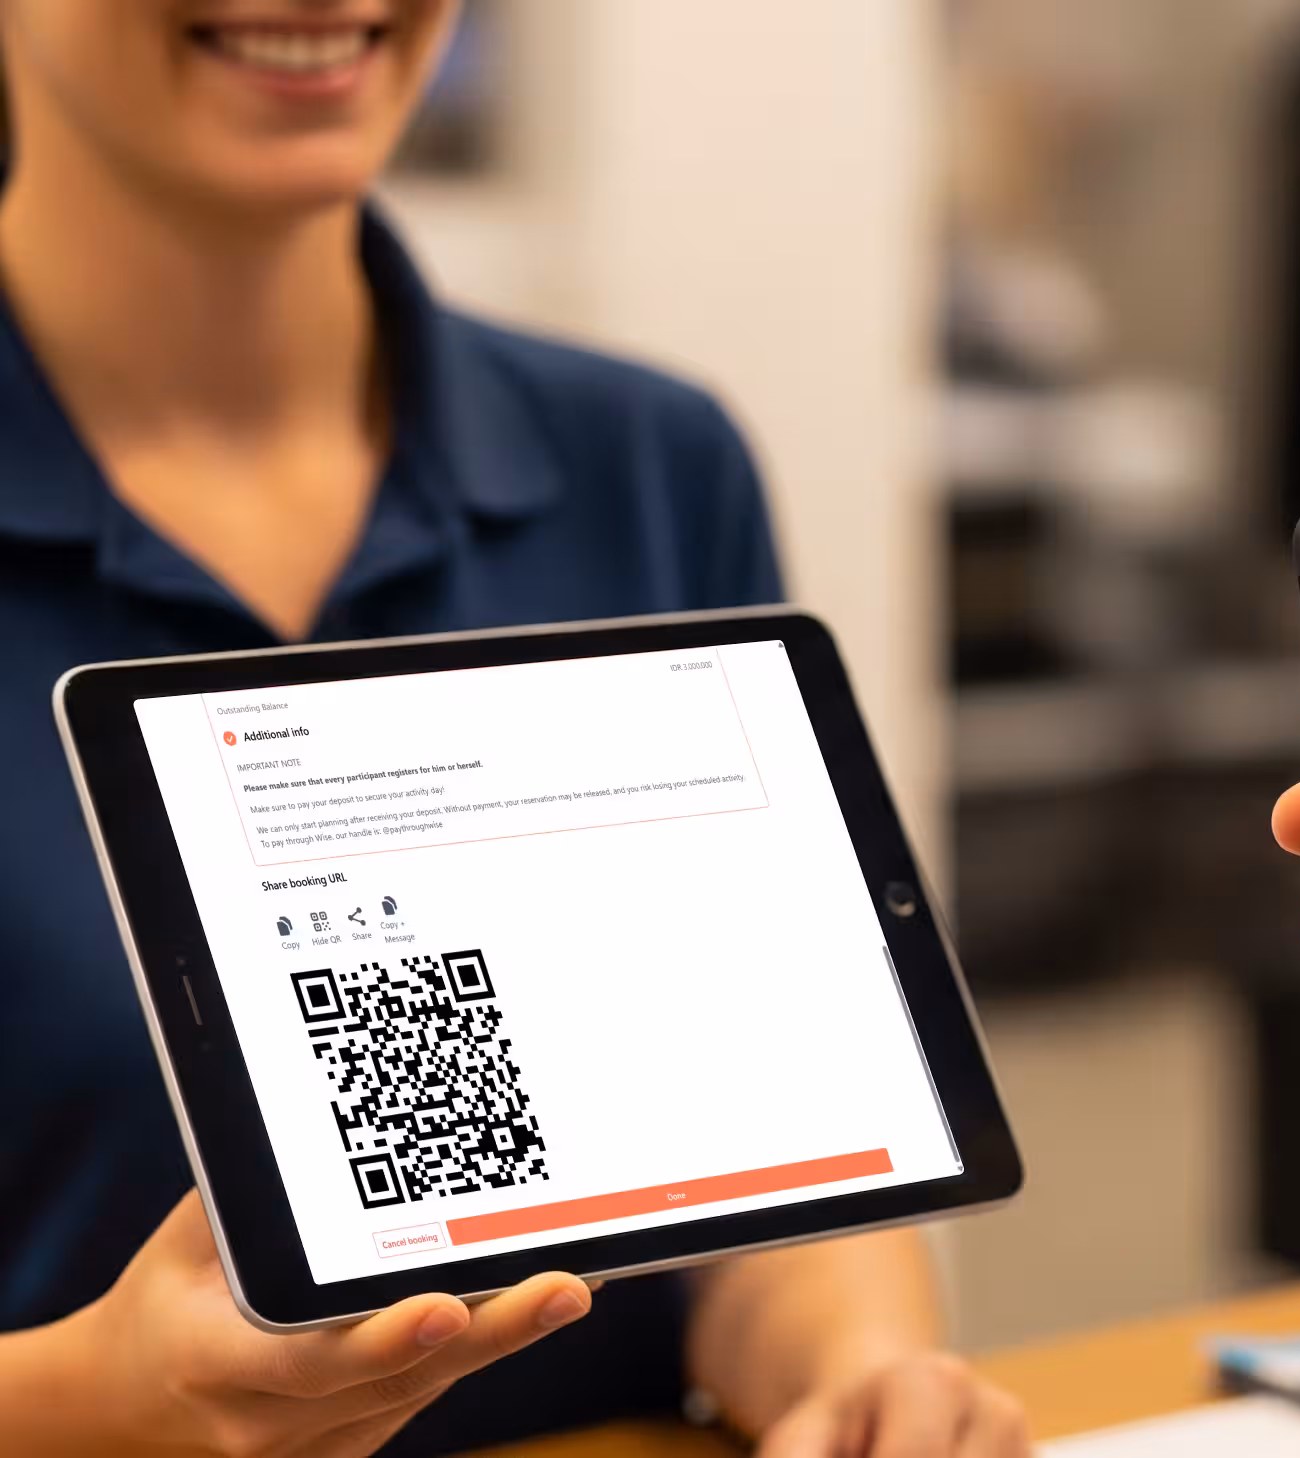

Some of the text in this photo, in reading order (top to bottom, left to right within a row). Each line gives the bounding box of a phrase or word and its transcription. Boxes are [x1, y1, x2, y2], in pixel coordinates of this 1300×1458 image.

[216, 703, 288, 715] Outstanding Balance
[244, 726, 309, 742] Additional info
[237, 758, 301, 773] IMPORTANT NOTE
[243, 784, 267, 792] Please
[268, 781, 289, 790] make
[324, 776, 345, 784] every
[346, 771, 386, 783] participant
[387, 769, 419, 778] registers
[419, 766, 430, 774] for
[456, 760, 483, 769] herself.
[250, 805, 270, 813] Make
[297, 802, 310, 811] pay
[311, 800, 327, 809] your
[329, 796, 355, 807] deposit
[388, 792, 404, 800] your
[405, 788, 429, 797] activity
[256, 826, 269, 834] We
[284, 823, 299, 832] only
[301, 821, 317, 830] start
[318, 818, 349, 829] planning
[349, 816, 365, 824] after
[367, 812, 399, 822] receiving
[399, 812, 414, 820] your
[443, 804, 472, 813] Without
[472, 801, 504, 812] payment,
[504, 800, 519, 808] your
[520, 795, 557, 804] reservation
[583, 788, 612, 798] released,
[613, 786, 626, 794] and
[626, 787, 639, 795] you
[652, 782, 673, 790] losing
[673, 781, 687, 790] your
[688, 776, 721, 786] scheduled
[260, 840, 270, 848] To
[271, 840, 284, 848] pay
[285, 835, 314, 845] through
[348, 829, 372, 837] handle
[261, 872, 348, 891] Share booking URL
[380, 922, 398, 930] Copy
[312, 935, 342, 946] Hide QR
[352, 933, 372, 941] Share
[384, 934, 415, 943] Message
[281, 942, 300, 950] Copy
[667, 1193, 686, 1201] Done
[382, 1234, 438, 1249] Cancel booking
